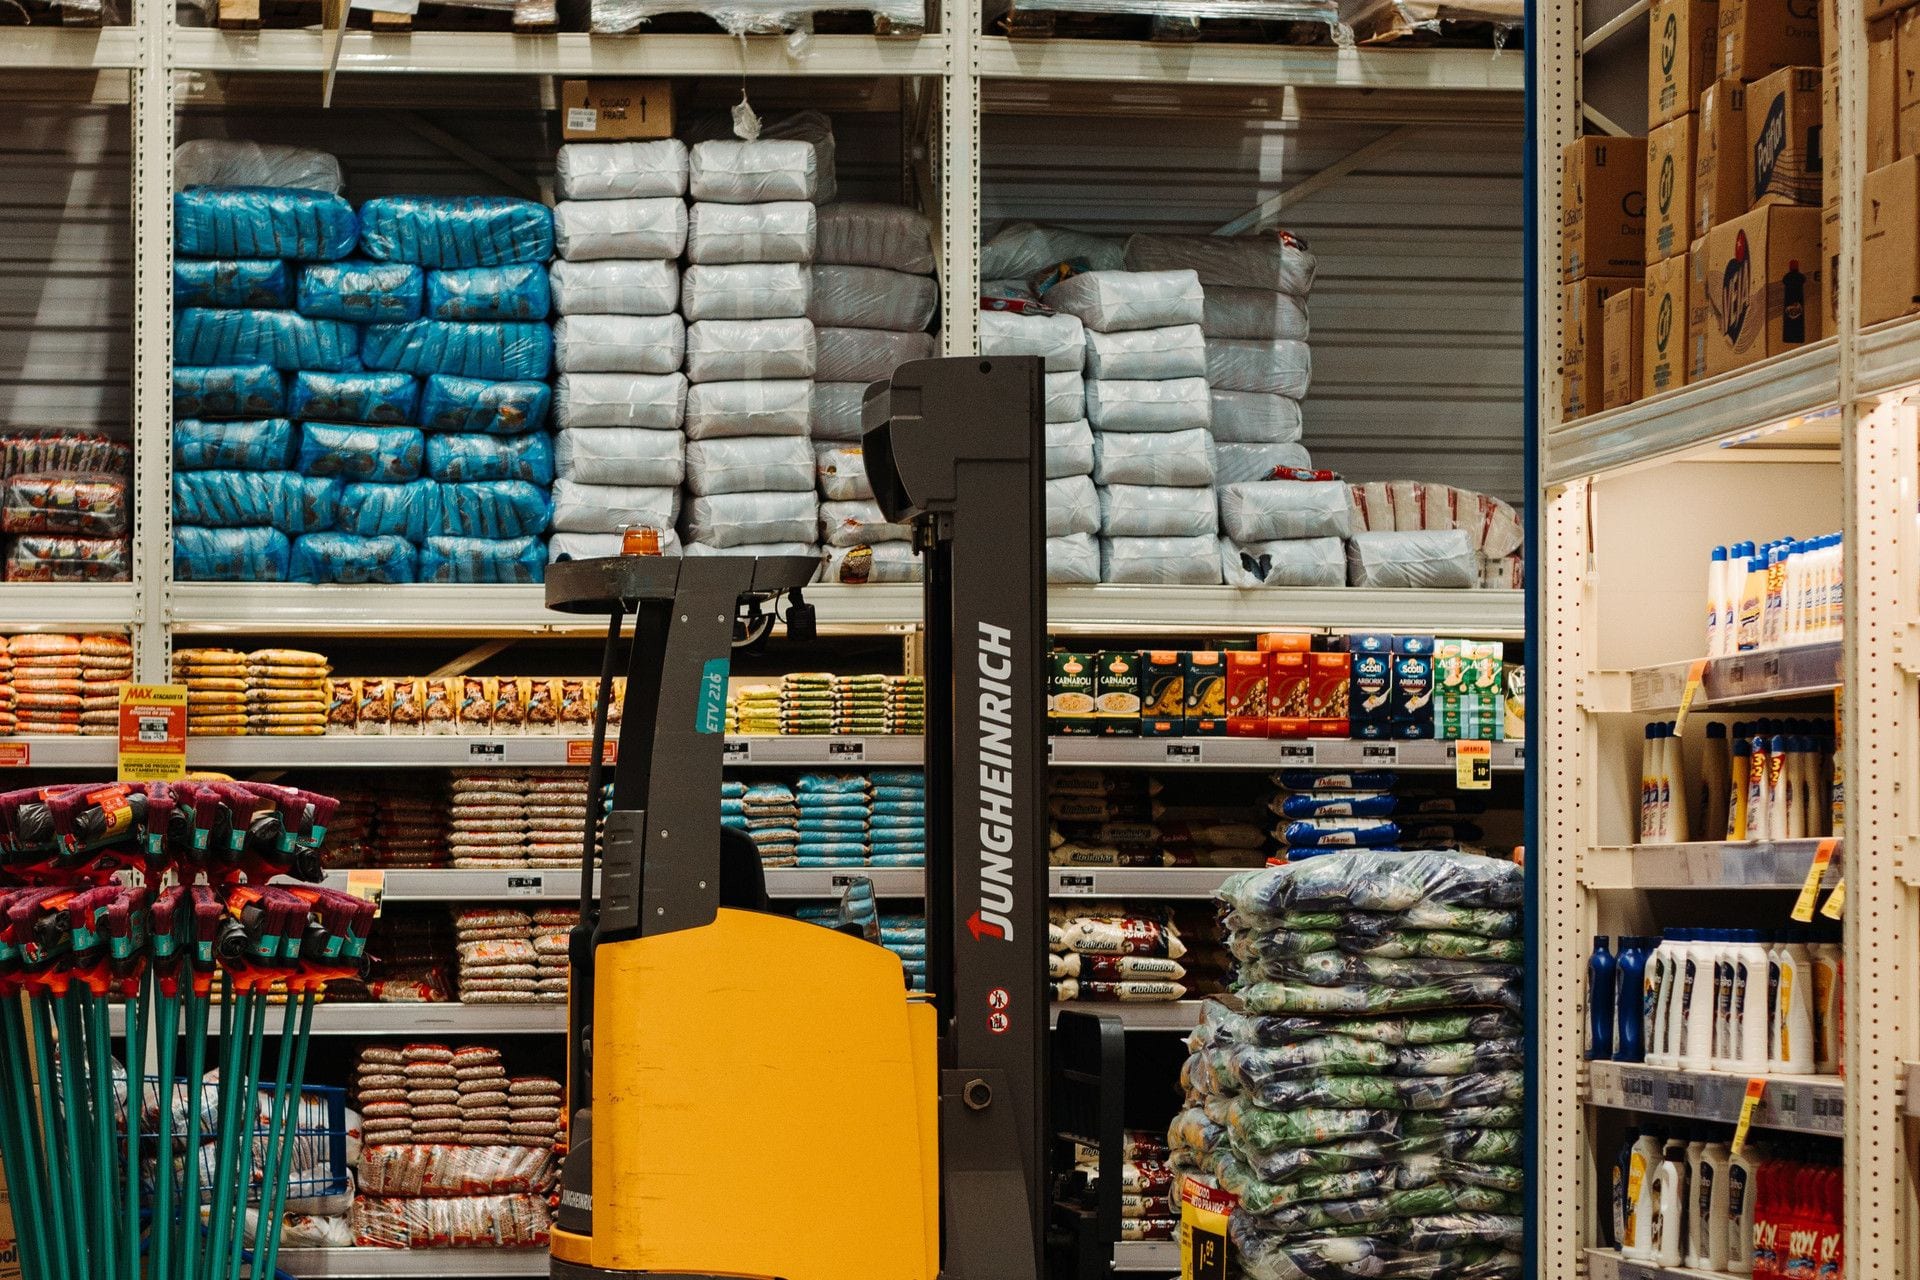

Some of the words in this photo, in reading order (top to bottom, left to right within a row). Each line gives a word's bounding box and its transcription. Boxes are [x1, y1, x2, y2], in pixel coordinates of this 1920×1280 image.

[601, 98, 630, 107] CUIDADO
[1359, 662, 1382, 673] Scotti
[1401, 663, 1424, 674] Scotti
[709, 673, 722, 701] 216
[1054, 676, 1092, 685] CARNAROLI
[1100, 676, 1138, 685] CARNAROLI
[124, 688, 153, 702] MAX
[706, 702, 720, 733] ETV
[1754, 752, 1766, 765] 3
[1772, 758, 1781, 771] 3
[1755, 766, 1763, 777] 2
[967, 621, 1014, 942] JUNGHEINRICH
[561, 1189, 593, 1211] JUNGHEINRIC
